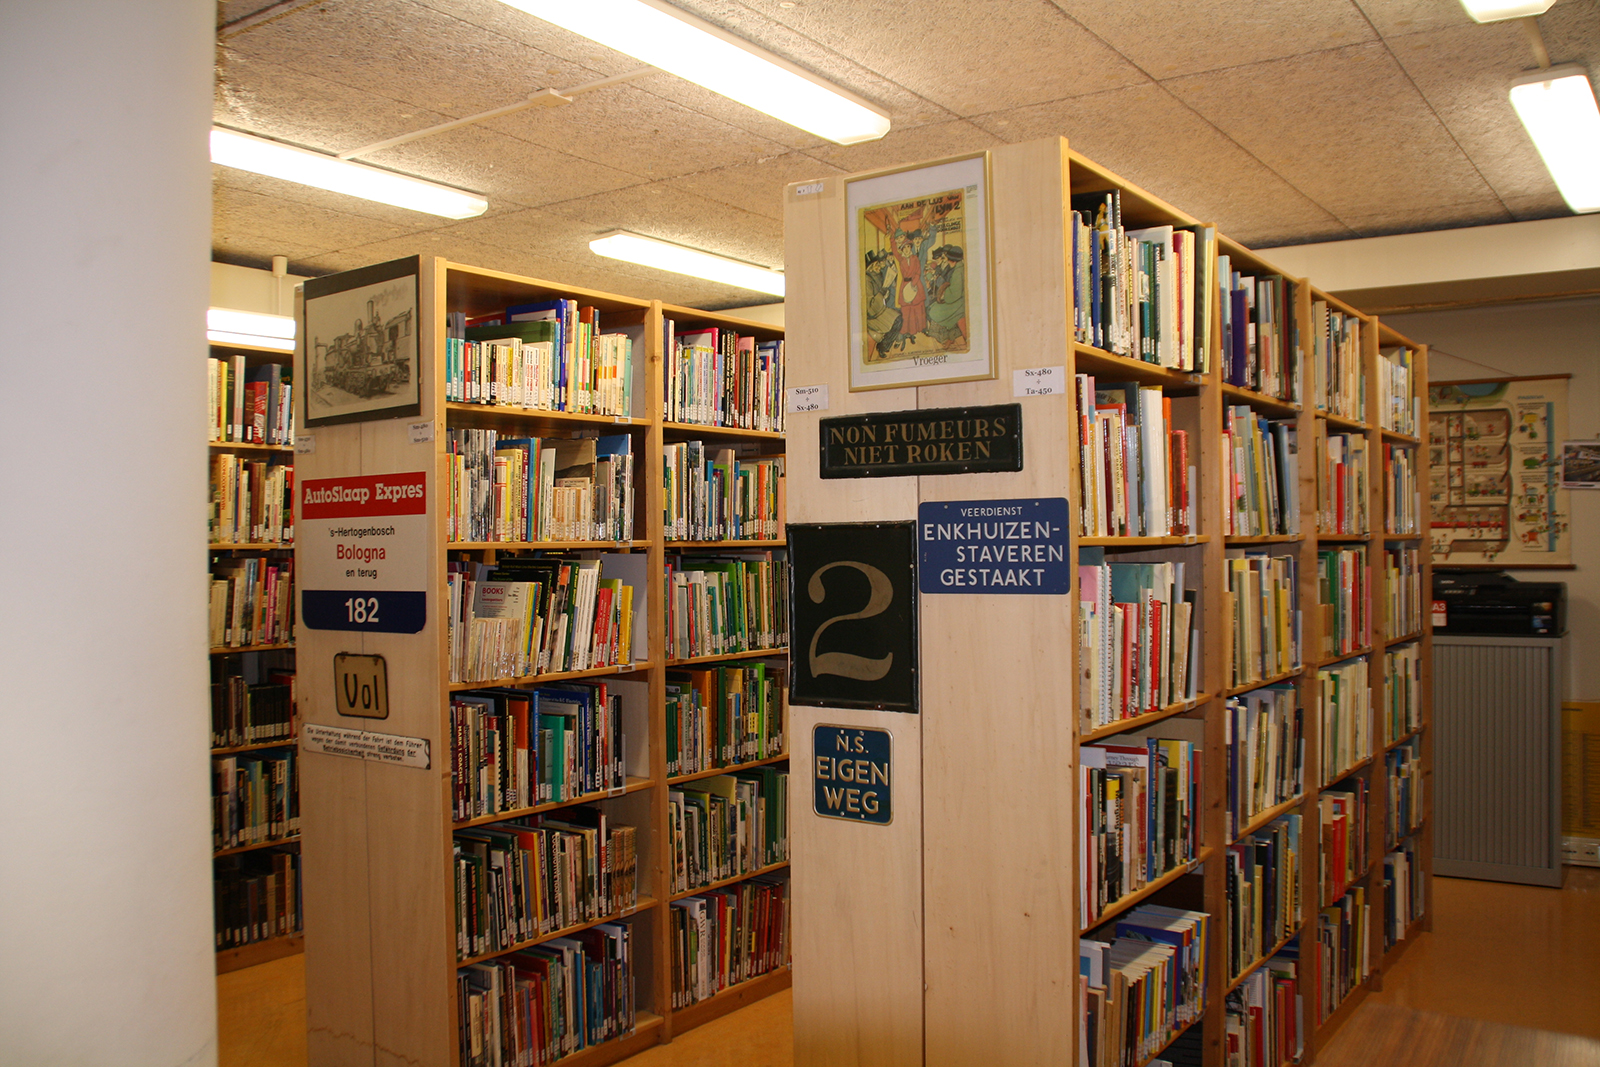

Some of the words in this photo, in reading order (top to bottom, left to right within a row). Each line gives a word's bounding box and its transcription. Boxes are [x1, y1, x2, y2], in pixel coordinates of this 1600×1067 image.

[912, 354, 948, 366] Vroeger
[1025, 368, 1052, 377] Sx-480
[795, 387, 819, 396] Sm-510
[1025, 386, 1053, 395] Ta-450
[796, 403, 819, 412] Sx-480
[829, 424, 876, 445] NON
[885, 417, 1007, 443] FUMEURS
[844, 444, 901, 466] NIET
[906, 440, 991, 463] ROKEN
[304, 486, 370, 504] AutoSlaap
[375, 483, 424, 503] Expres
[960, 506, 1023, 517] VEERDIENST
[328, 525, 395, 539] 's-Hertogenbosch
[923, 521, 1060, 541] ENKHUIZEN-
[336, 544, 386, 563] Bologna
[956, 545, 1064, 562] STAVEREN
[345, 569, 355, 577] en
[357, 568, 378, 579] terug
[940, 569, 1045, 586] GESTAAKT
[344, 597, 379, 623] 182
[807, 560, 894, 681] 2
[344, 673, 379, 710] Vol
[836, 734, 869, 754] N.S.
[816, 755, 889, 786] EIGEN
[822, 785, 879, 814] WEG
